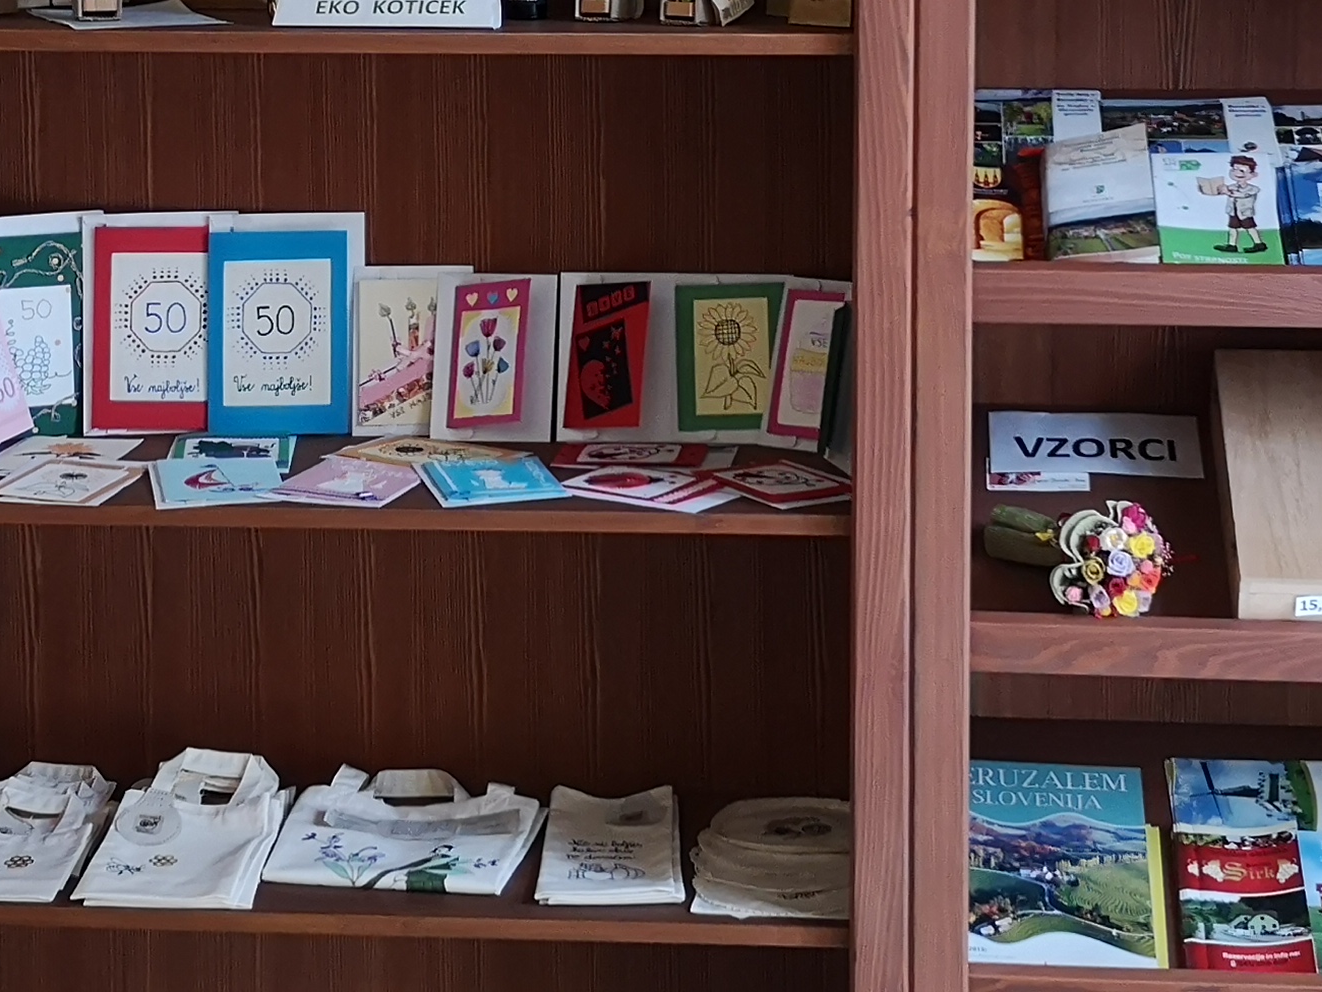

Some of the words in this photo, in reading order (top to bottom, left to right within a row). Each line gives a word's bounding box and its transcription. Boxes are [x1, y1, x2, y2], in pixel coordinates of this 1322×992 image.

[316, 0, 360, 15] EKO
[21, 298, 52, 320] 50
[144, 302, 187, 334] 50
[256, 305, 296, 337] 50
[124, 374, 144, 394] Vse
[233, 374, 255, 394] Vse
[1014, 435, 1177, 463] VZORCI
[972, 789, 1103, 811] SLOVENIJA
[1221, 861, 1275, 881] Sirk
